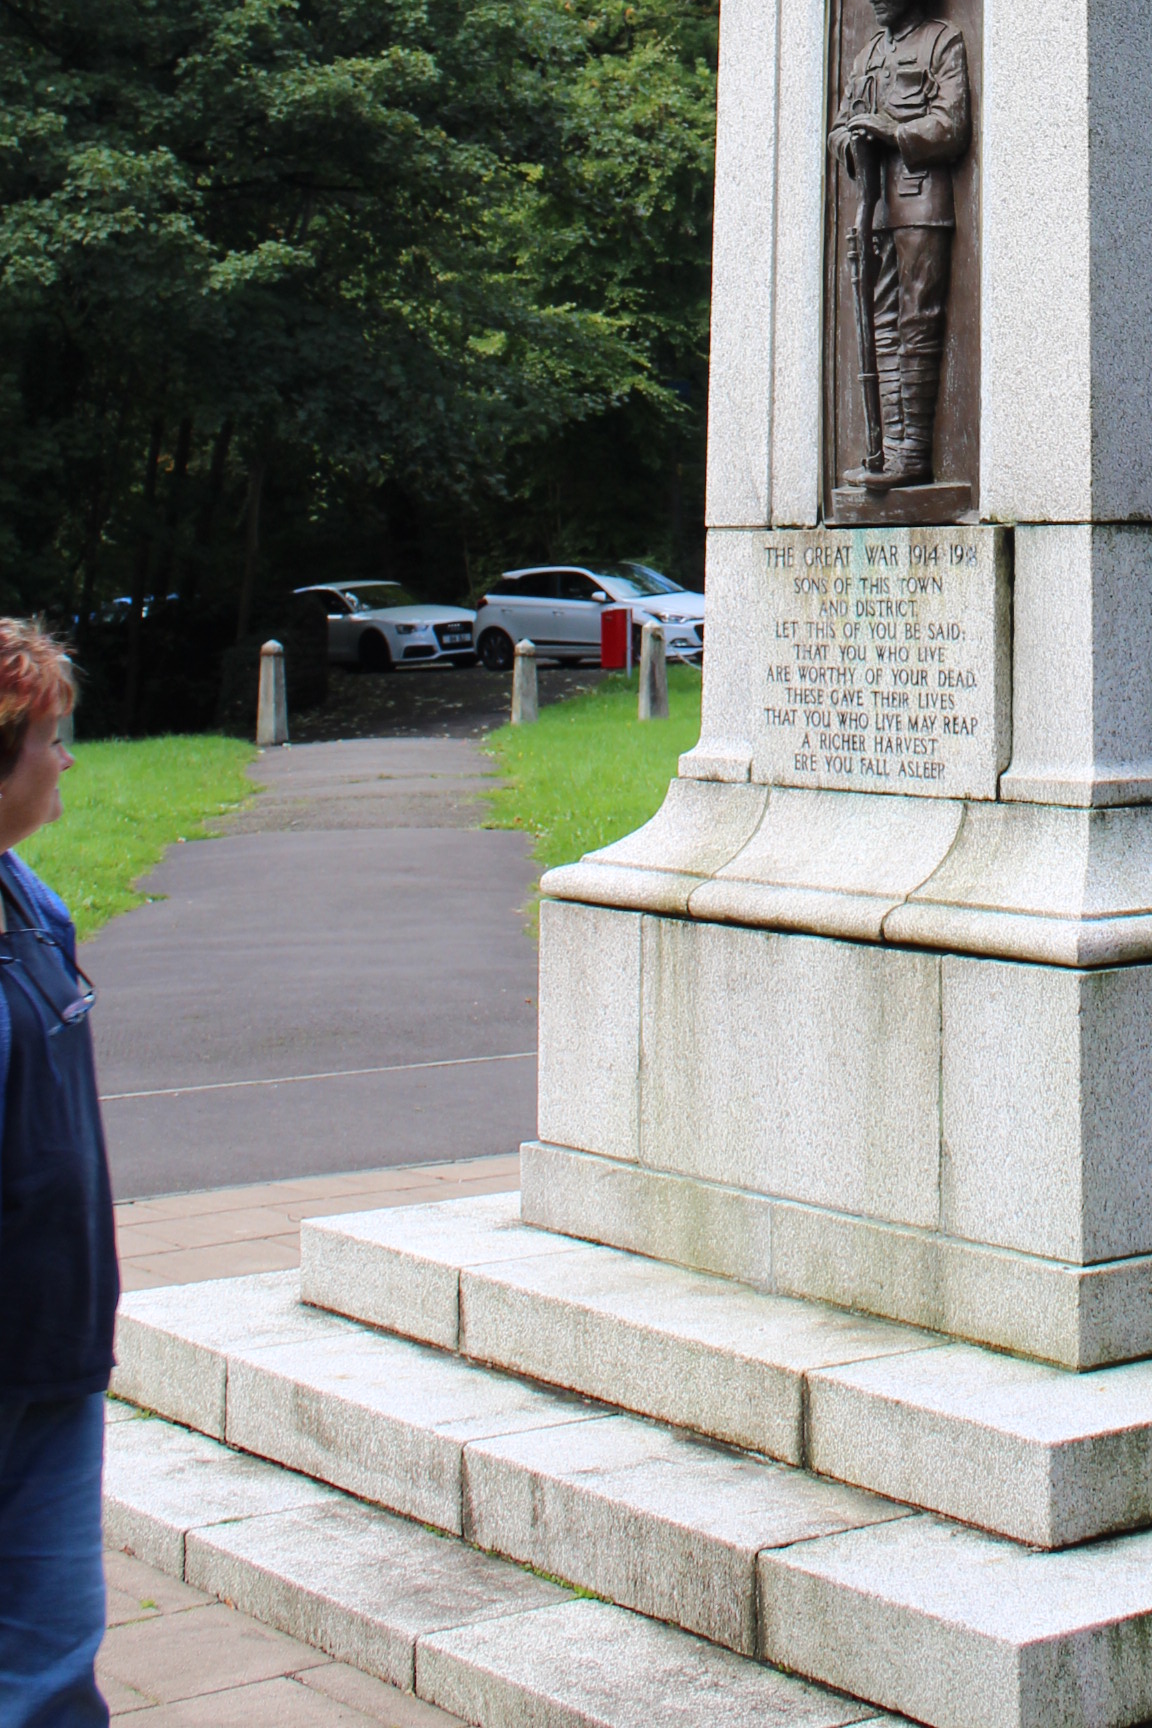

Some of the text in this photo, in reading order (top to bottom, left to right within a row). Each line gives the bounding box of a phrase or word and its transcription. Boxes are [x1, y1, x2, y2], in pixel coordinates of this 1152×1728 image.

[765, 547, 794, 567] THE
[803, 546, 851, 567] GREAT
[865, 546, 899, 566] WAR
[908, 546, 939, 567] 1914
[794, 577, 942, 594] SONS OF THIS TOWN
[820, 600, 847, 617] AND
[775, 622, 798, 638] LET
[806, 622, 835, 639] THIS
[843, 623, 860, 639] OF
[868, 623, 896, 639] YOU
[905, 623, 921, 639] BE
[794, 644, 945, 663] THAT YOU WHO LIVE
[766, 665, 977, 688] ARE WORTHY OF YOUR DEAD.
[786, 687, 955, 709] THESE GAVE THEIR LIVES
[765, 708, 979, 735] THAT YOU WHO LIVE MAY REAP
[802, 733, 939, 755] A RICHER HARVEST
[794, 753, 817, 771] ERE
[825, 755, 851, 773] YOU
[860, 757, 890, 776] FALL
